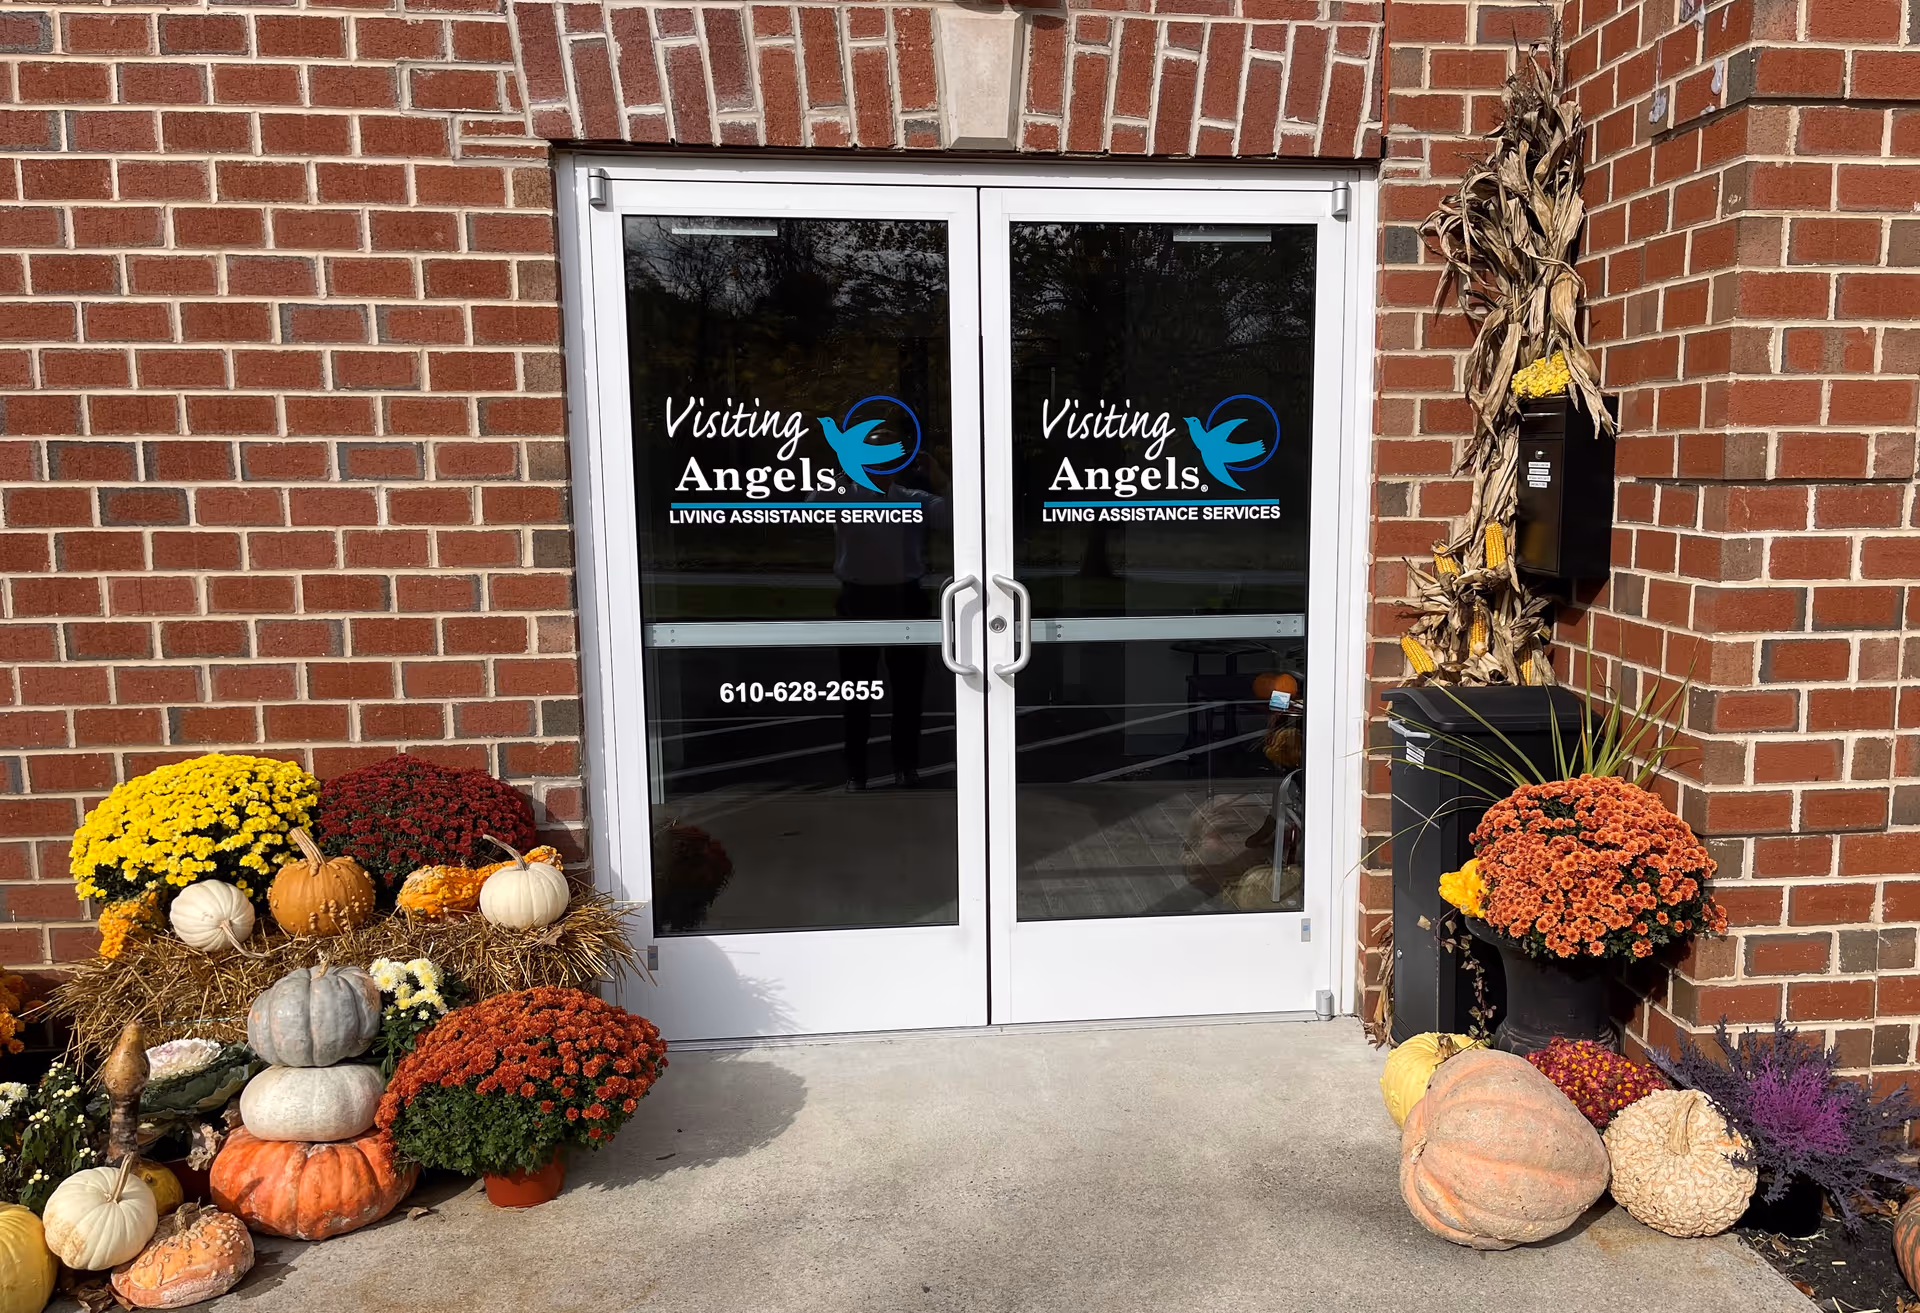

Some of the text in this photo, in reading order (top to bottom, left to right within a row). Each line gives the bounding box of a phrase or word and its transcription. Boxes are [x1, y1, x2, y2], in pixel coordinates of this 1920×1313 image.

[666, 396, 809, 461] Visiting
[1042, 398, 1176, 460] Visiting
[669, 509, 924, 524] LIVING ASSISTANCE SERVICES
[1042, 505, 1281, 522] LIVING ASSISTANCE SERVICES
[719, 680, 885, 703] 610-628-2655
